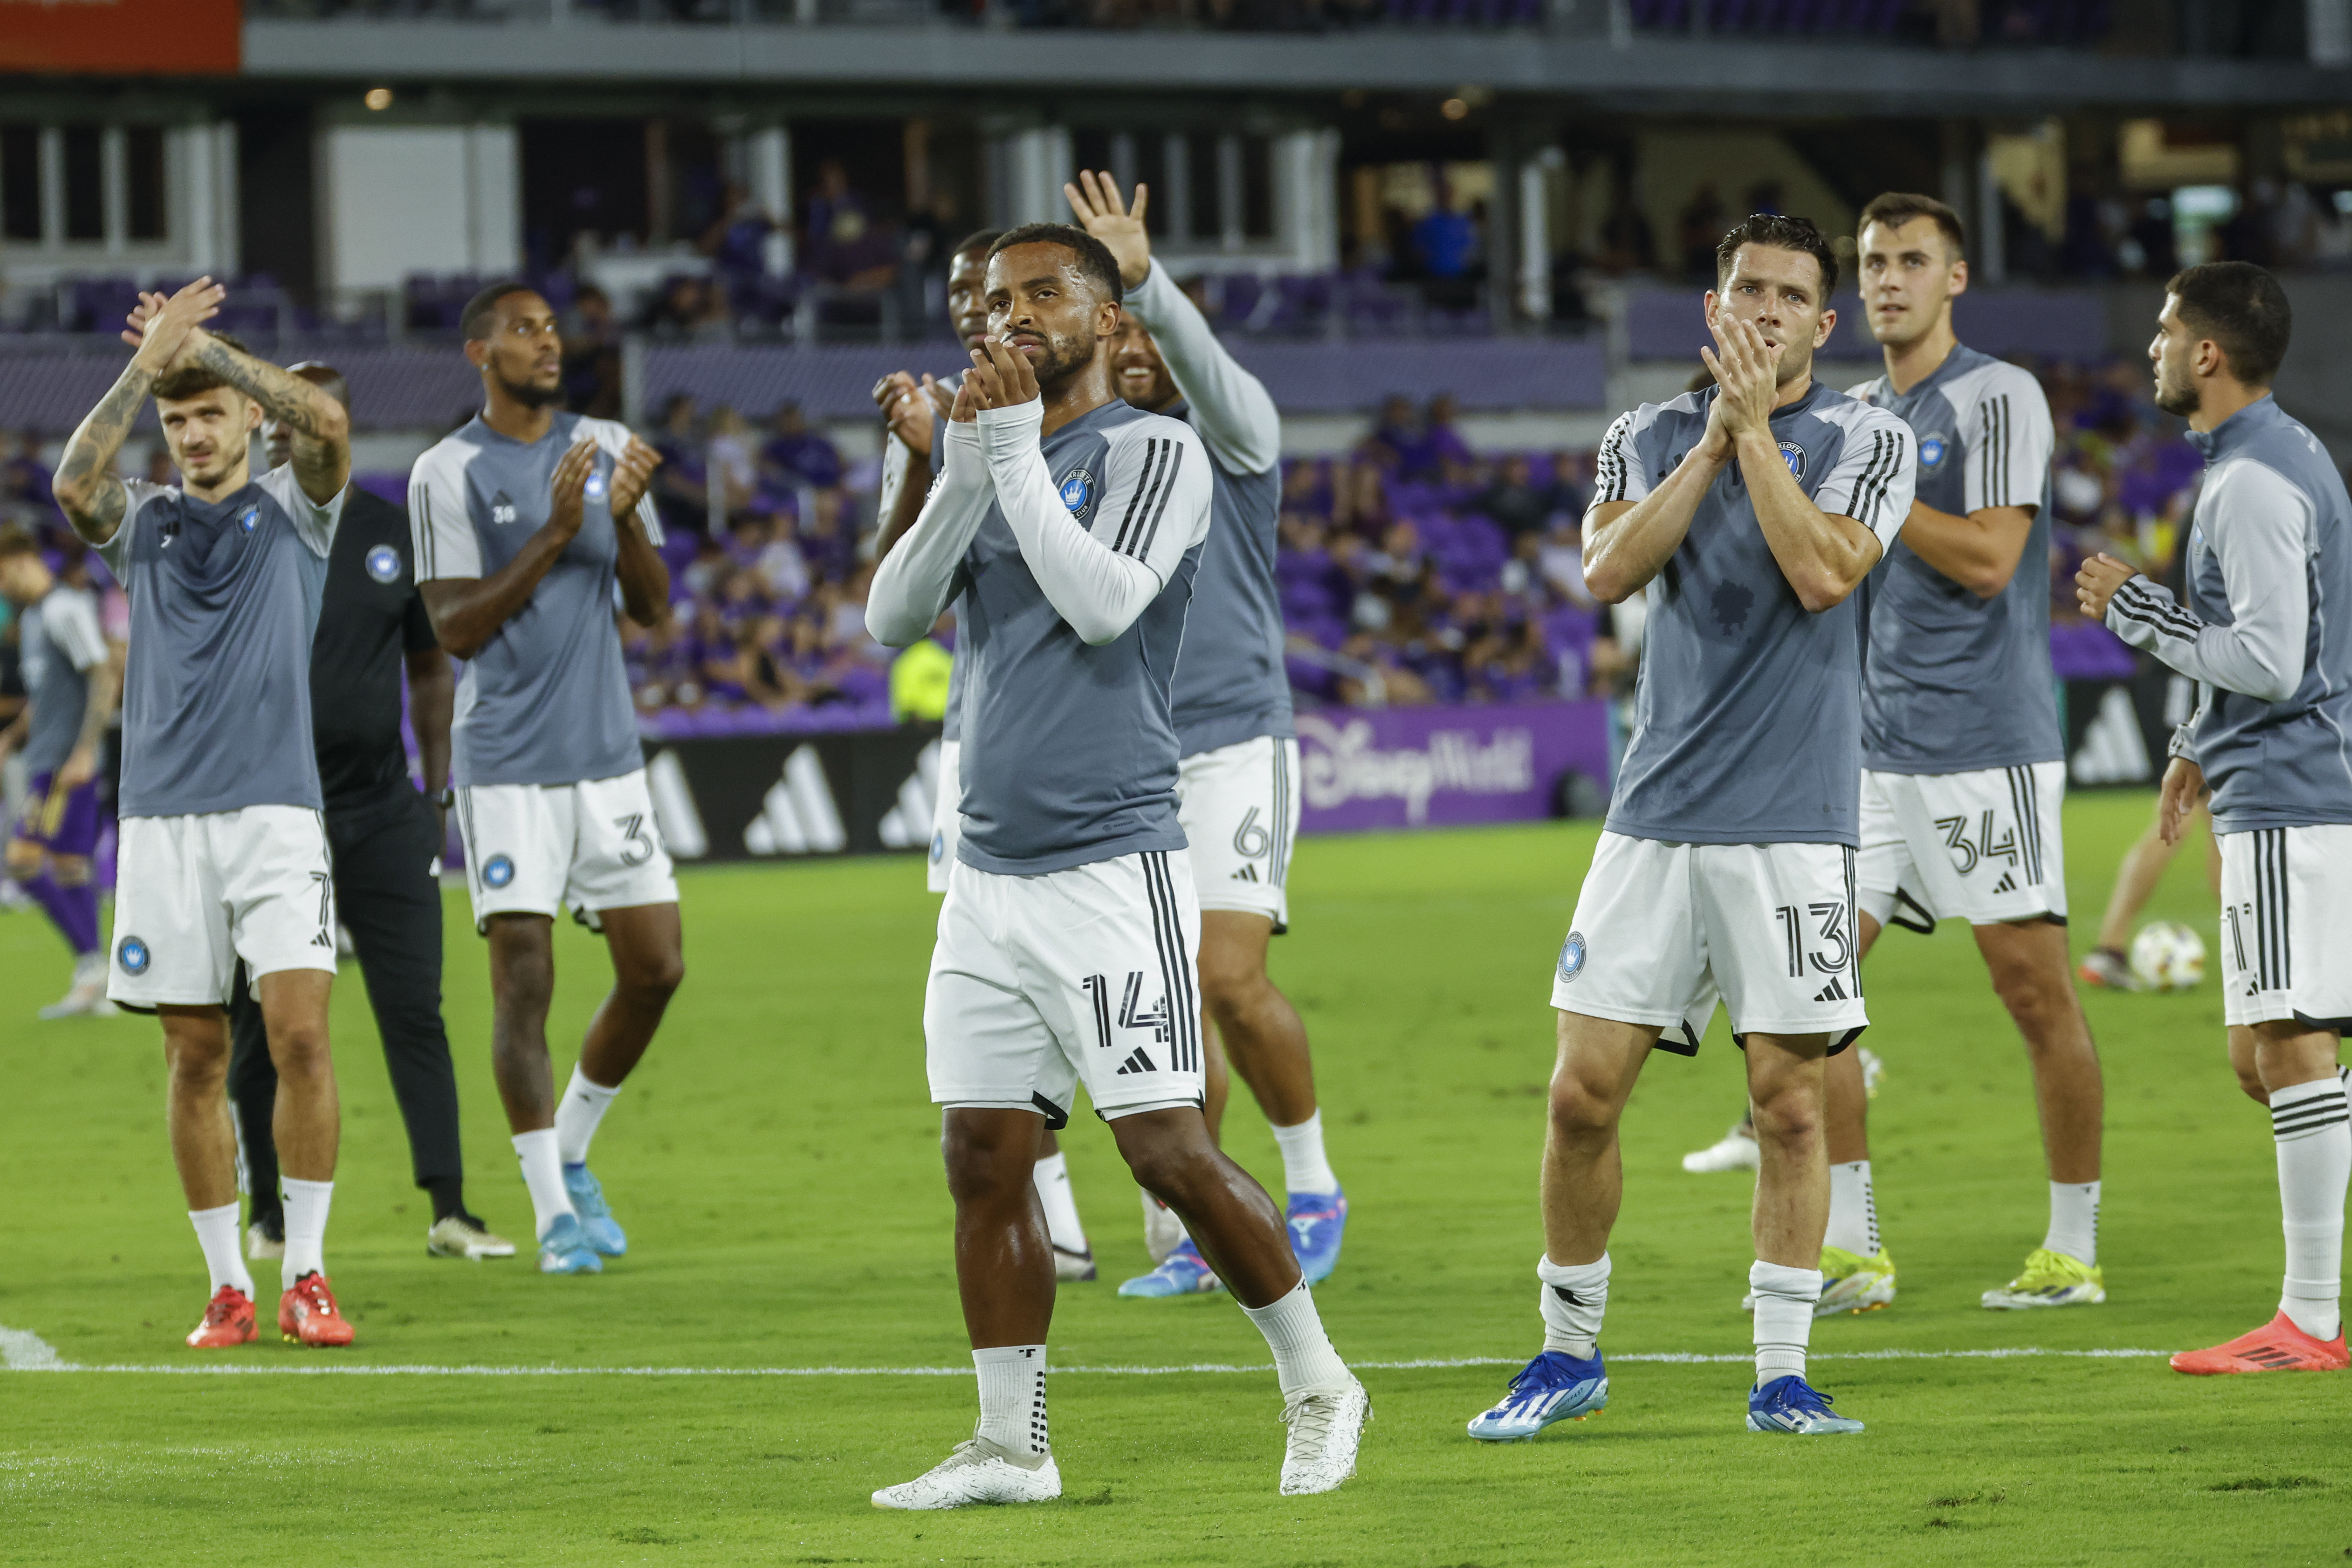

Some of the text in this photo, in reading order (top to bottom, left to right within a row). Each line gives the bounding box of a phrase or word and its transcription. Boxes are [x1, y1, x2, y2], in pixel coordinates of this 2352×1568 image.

[1778, 444, 1802, 455] RLOTTE
[1233, 805, 1269, 859] 6
[1934, 809, 2018, 877] 34
[1776, 902, 1850, 977] 13
[1082, 971, 1169, 1048] 14
